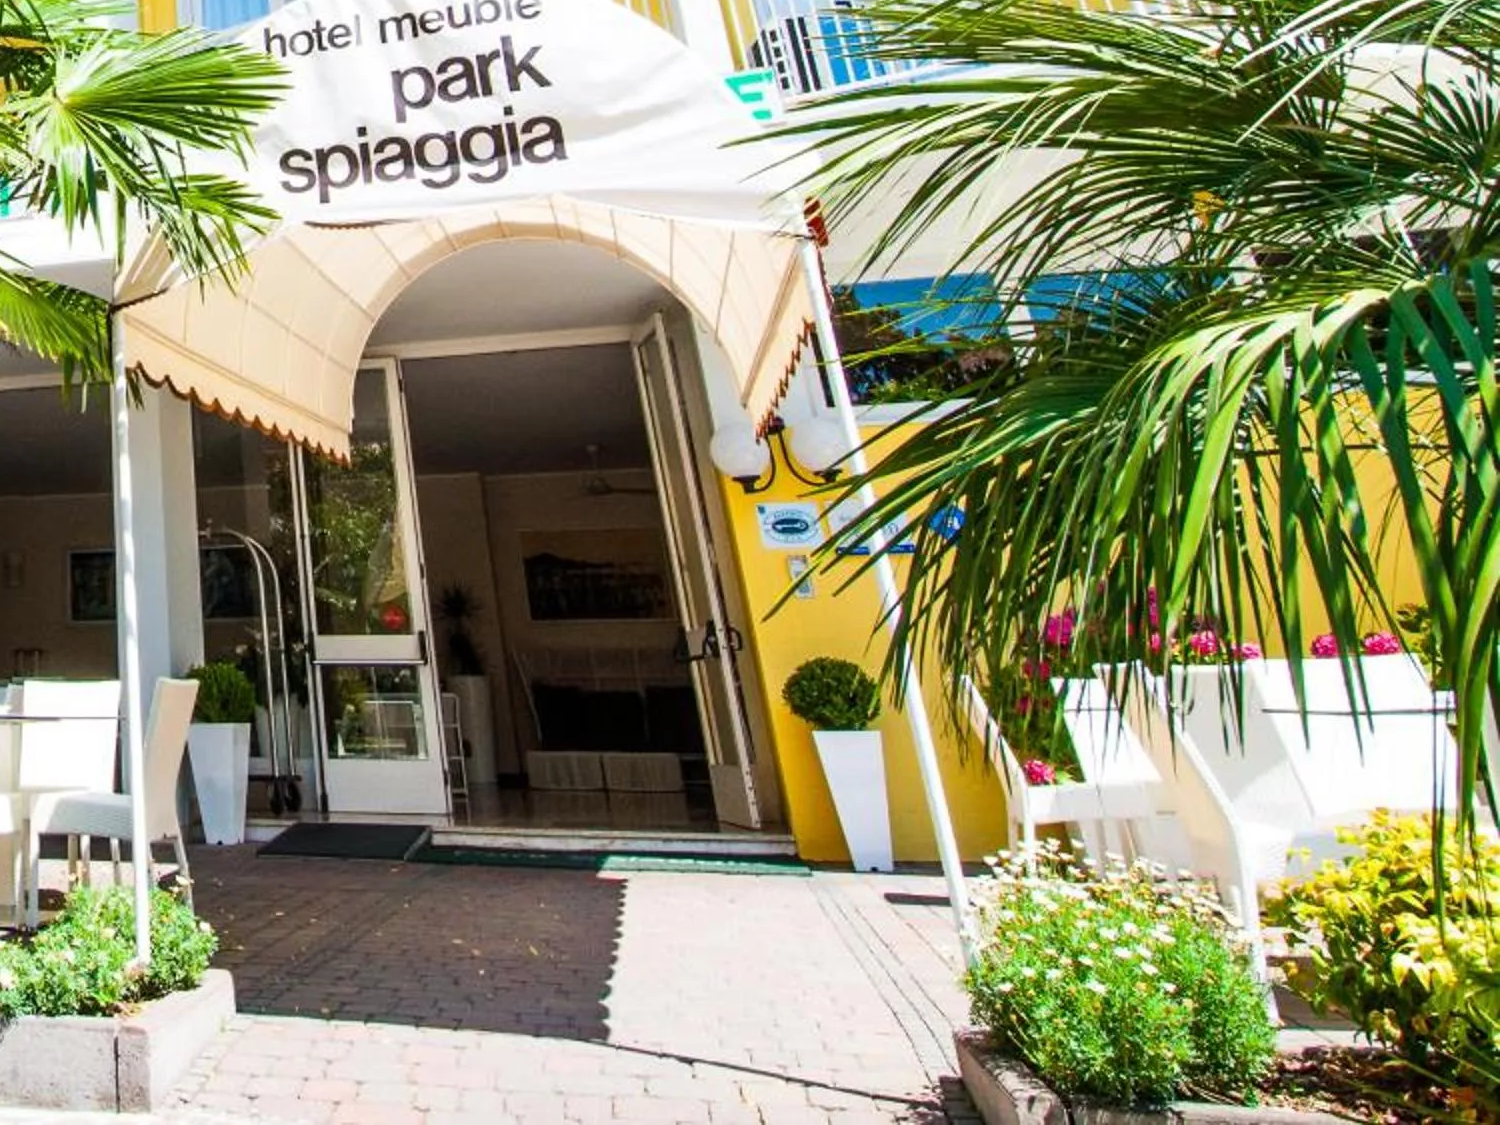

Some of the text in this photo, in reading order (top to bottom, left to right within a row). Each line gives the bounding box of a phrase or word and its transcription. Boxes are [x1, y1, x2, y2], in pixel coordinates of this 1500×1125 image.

[263, 14, 363, 58] hotel
[390, 35, 553, 124] park
[278, 104, 569, 204] spiaggia
